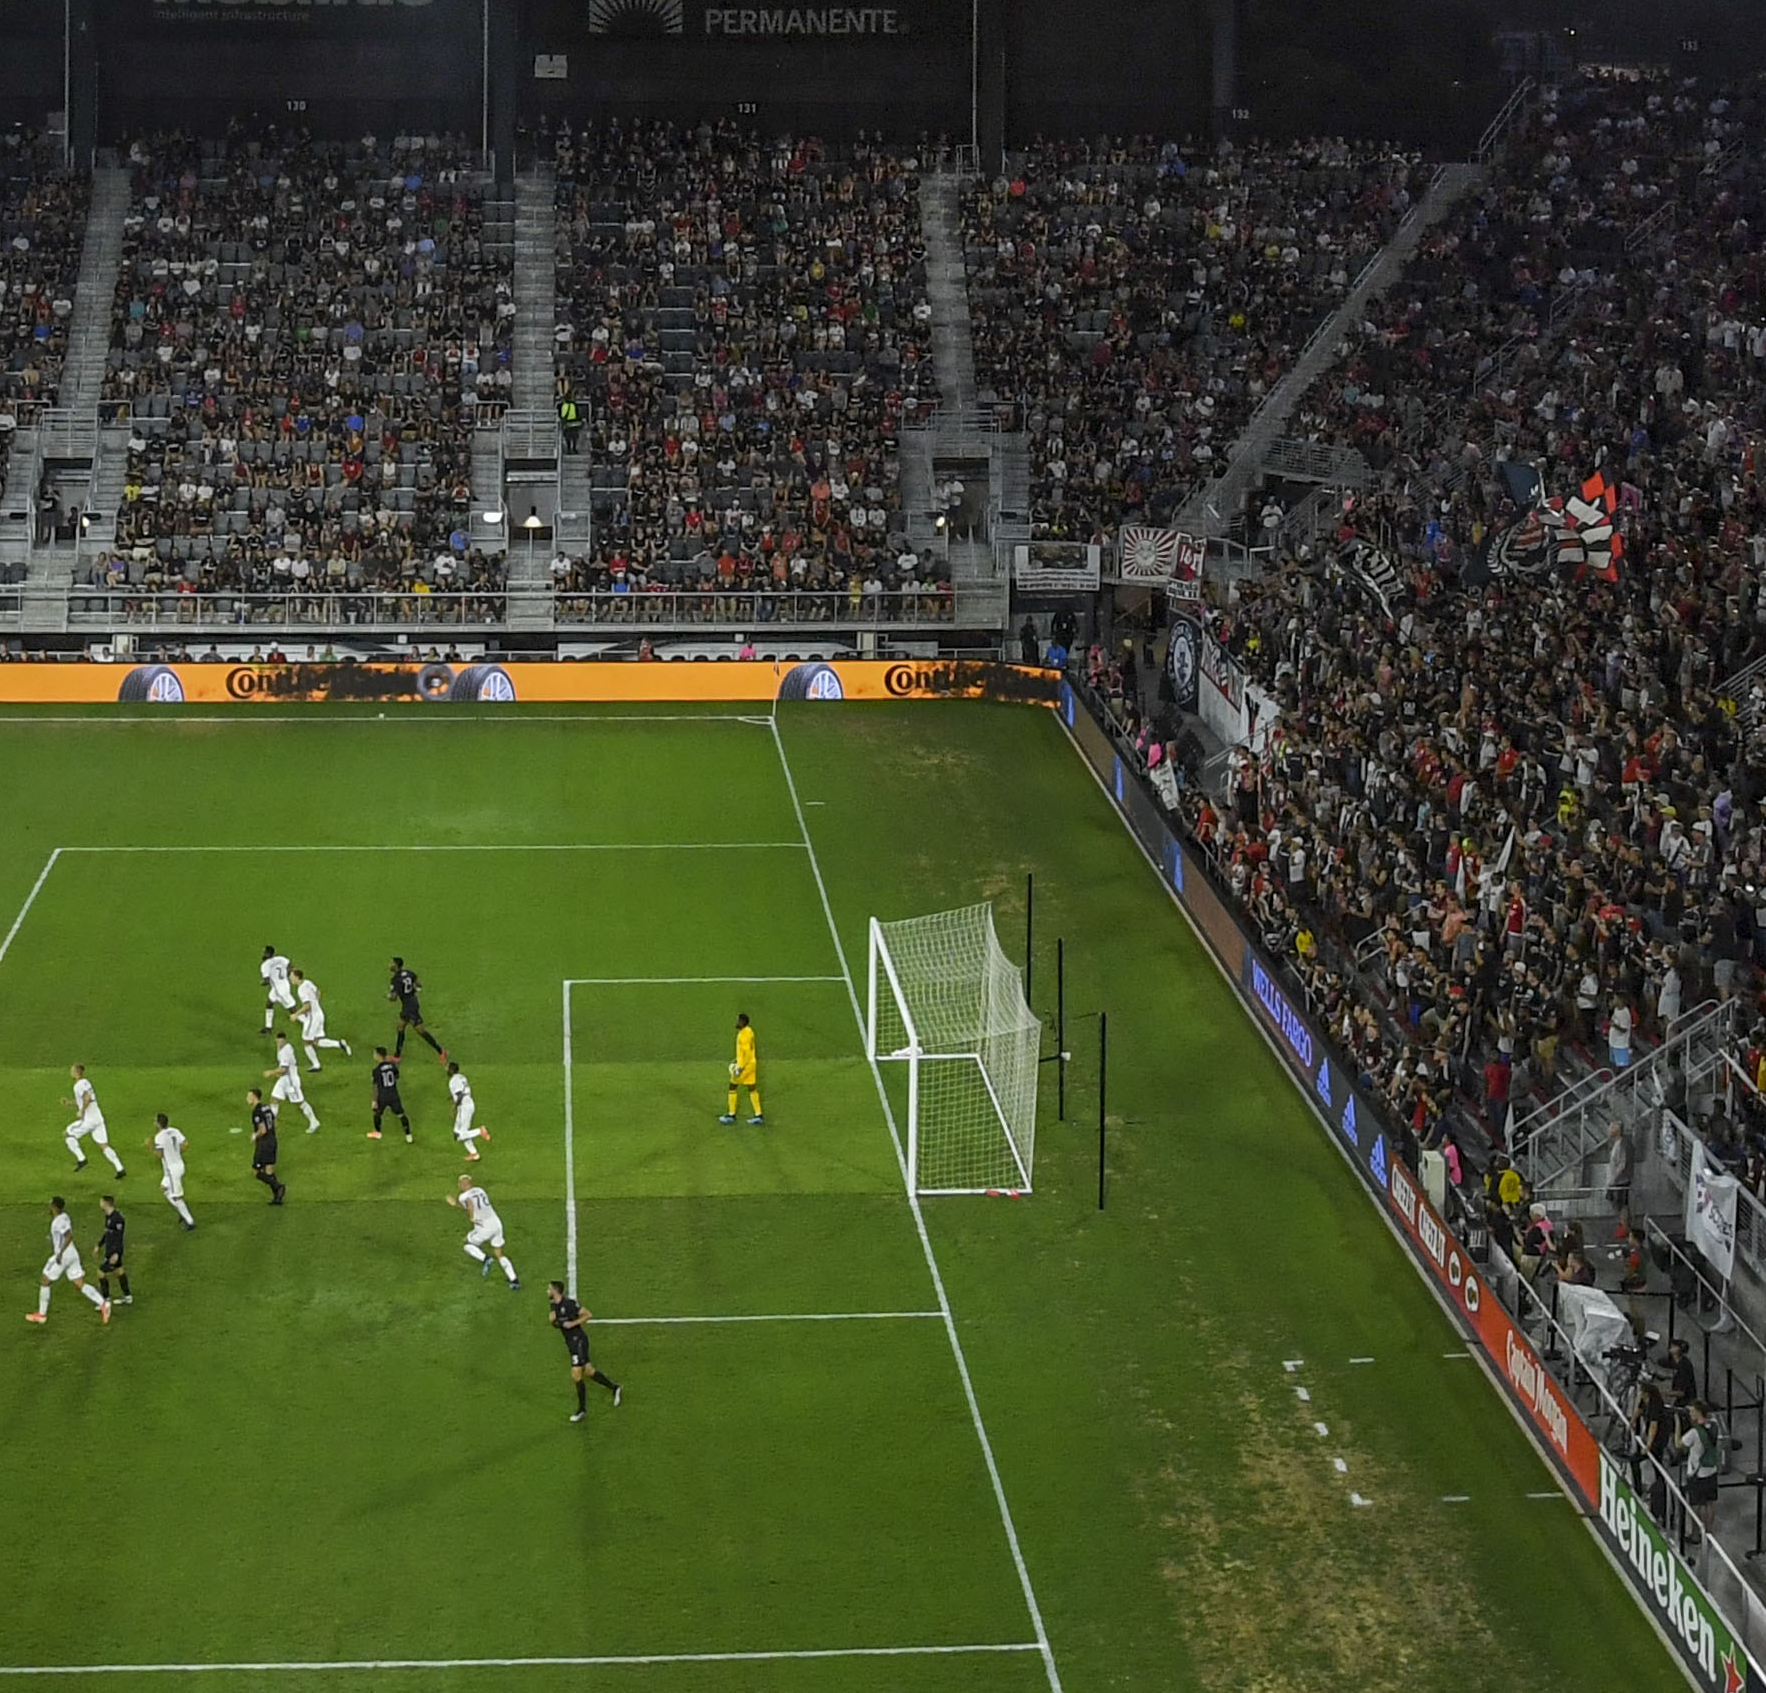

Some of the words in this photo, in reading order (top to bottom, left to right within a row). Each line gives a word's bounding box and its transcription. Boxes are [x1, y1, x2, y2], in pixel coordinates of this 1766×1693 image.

[704, 8, 899, 34] PERMANENTE
[738, 102, 757, 114] 131
[1281, 1000, 1313, 1068] FARGO
[381, 1070, 395, 1088] 10
[1506, 1329, 1536, 1402] Captain
[1533, 1362, 1568, 1455] Morgan
[1599, 1452, 1717, 1683] Heineken
